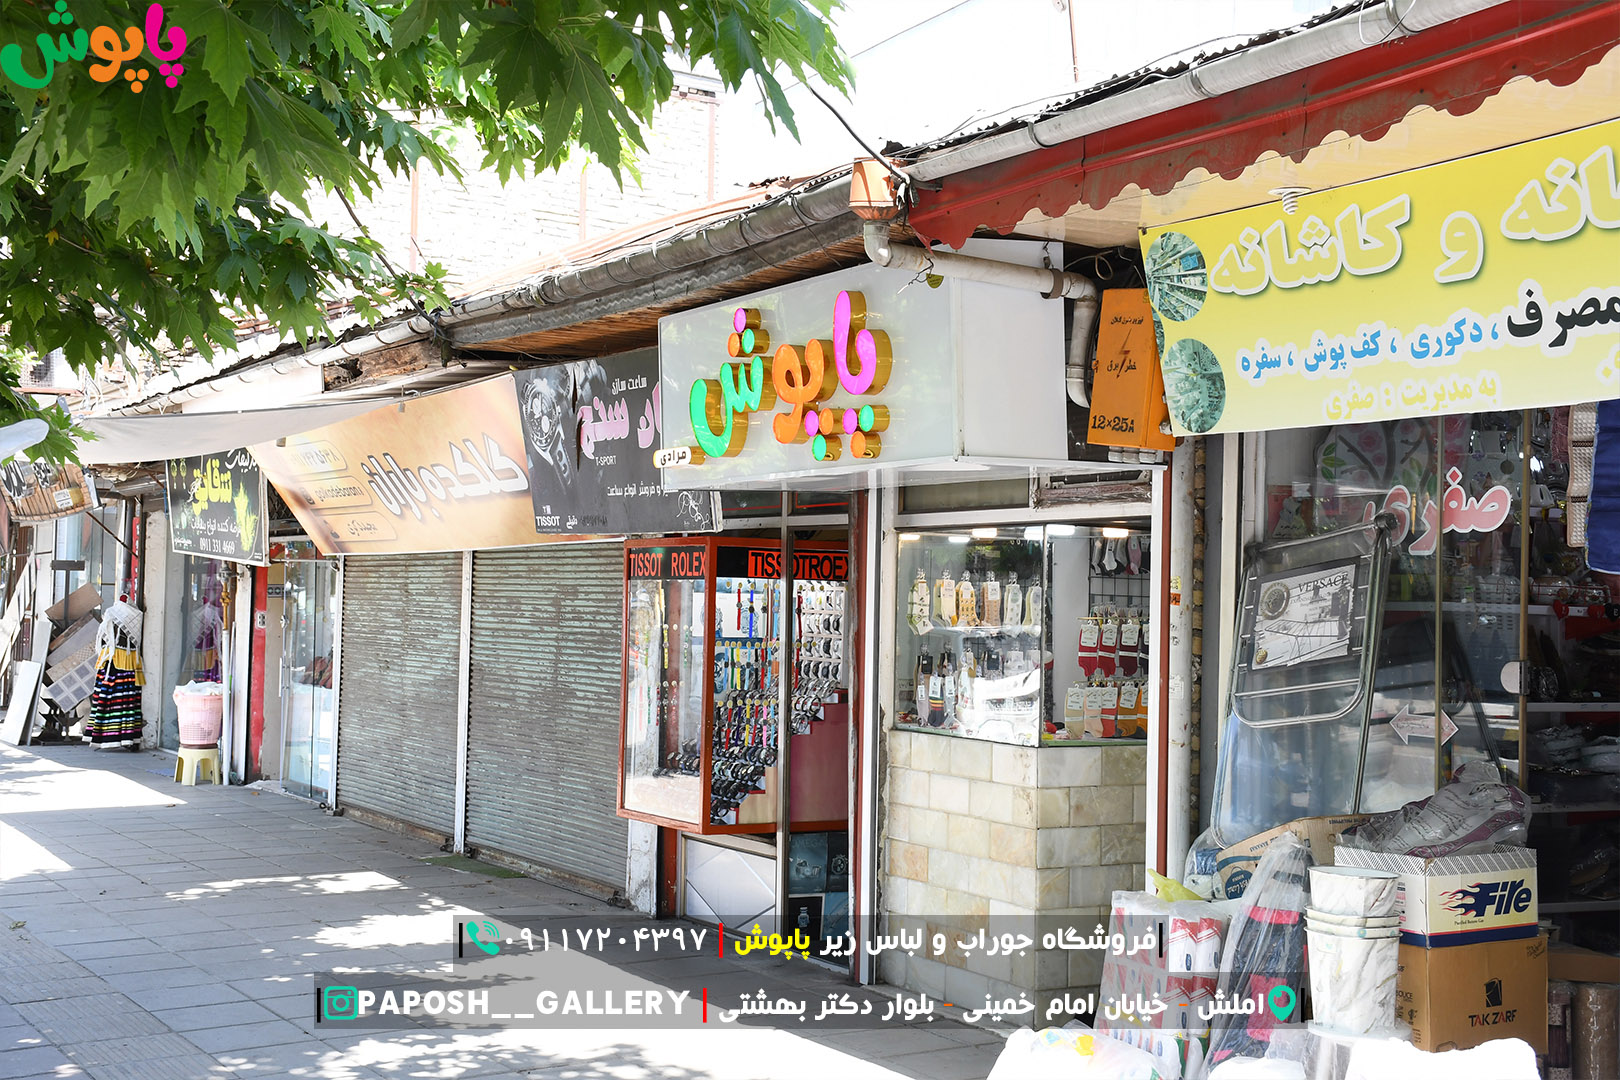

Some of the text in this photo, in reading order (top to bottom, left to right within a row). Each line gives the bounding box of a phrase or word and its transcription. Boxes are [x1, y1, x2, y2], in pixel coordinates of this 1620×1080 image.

[1209, 145, 1620, 296] انه و کاشانه
[1410, 317, 1483, 359] دکوری
[689, 290, 893, 462] پاپوش
[1124, 359, 1137, 373] خطر
[1241, 347, 1281, 379] سفره
[627, 374, 647, 391] ساعت
[1400, 380, 1473, 412] مدیریت
[1478, 376, 1498, 404] به
[1326, 384, 1375, 421] صفری
[595, 455, 617, 467] T-SPORT
[660, 449, 687, 466] مرادی
[360, 451, 441, 521] باران
[535, 515, 561, 527] TISSOT
[1362, 466, 1512, 556] صفری
[629, 551, 706, 577] TISSOT ROLEX
[1471, 879, 1532, 918] Fire
[1468, 1009, 1518, 1027] TAK ZARF
